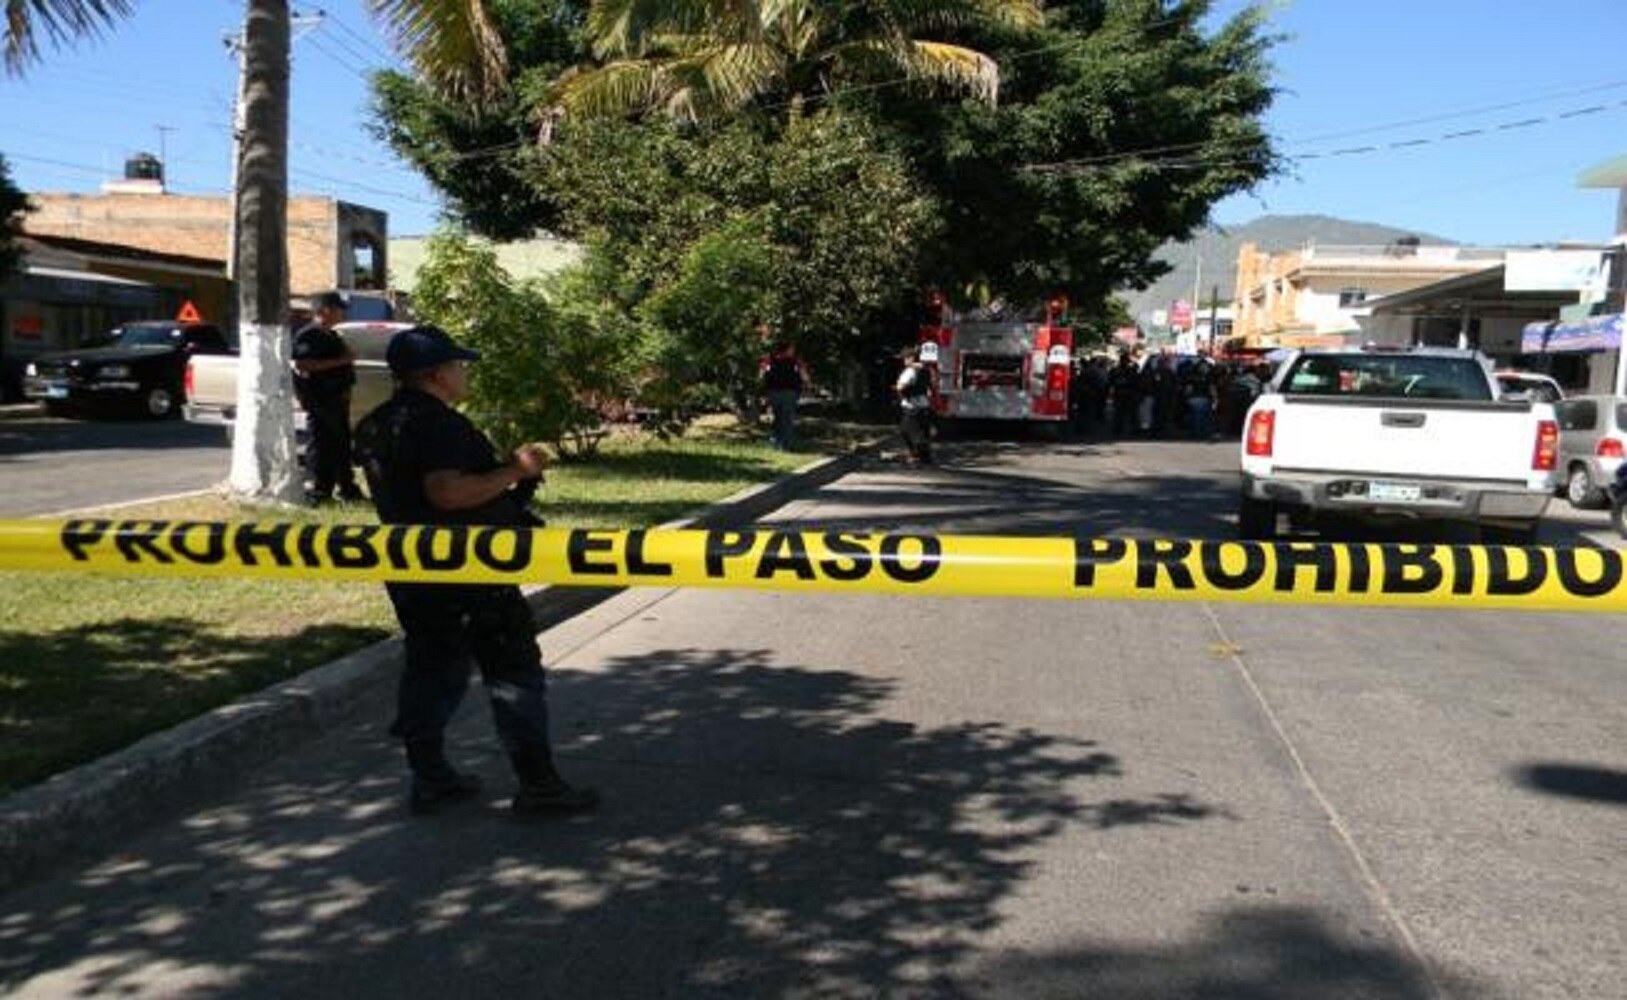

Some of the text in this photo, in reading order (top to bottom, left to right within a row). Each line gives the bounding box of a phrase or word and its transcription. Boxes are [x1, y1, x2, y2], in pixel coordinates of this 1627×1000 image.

[61, 520, 1623, 597] PROHIBIDO EL PASO PROHIBIDO
